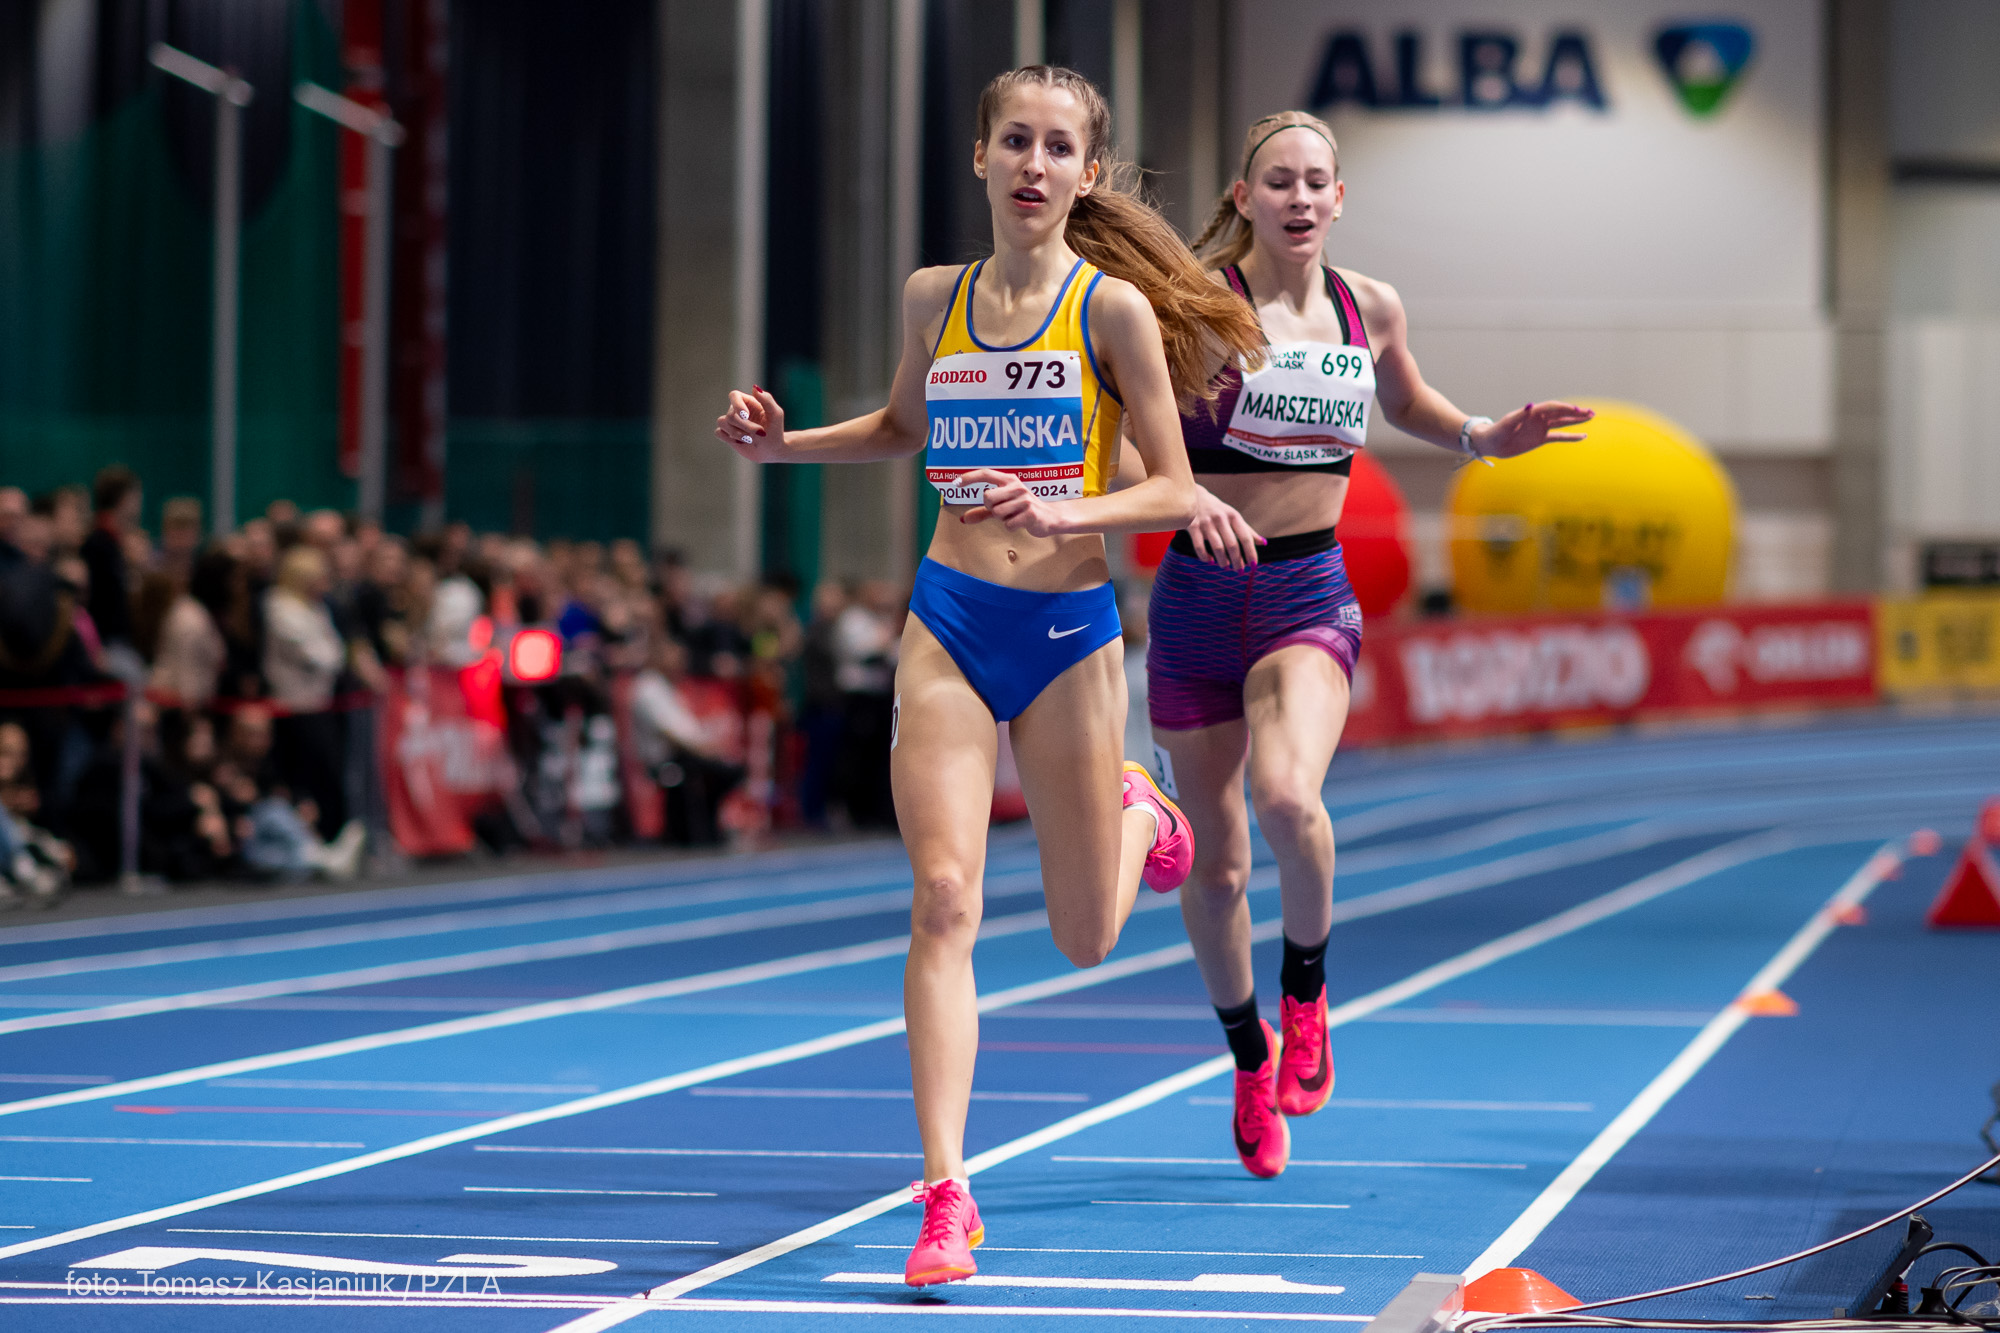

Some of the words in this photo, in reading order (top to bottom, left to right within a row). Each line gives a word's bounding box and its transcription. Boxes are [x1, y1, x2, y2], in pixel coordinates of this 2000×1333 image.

[1308, 28, 1612, 112] ALBA
[929, 370, 988, 385] BODZIO
[1005, 360, 1066, 390] 973
[1321, 352, 1363, 379] 699
[1241, 391, 1364, 429] MARSZEWSKA
[932, 408, 1078, 450] DUDZIŃSKA
[1284, 449, 1318, 462] ŚLĄSK
[1321, 448, 1343, 459] 2024
[929, 472, 944, 480] PZLA
[1018, 470, 1043, 480] Polski
[1044, 469, 1058, 479] U18
[1064, 467, 1080, 477] U20
[939, 486, 980, 499] DOLNY
[1031, 484, 1068, 497] 2024
